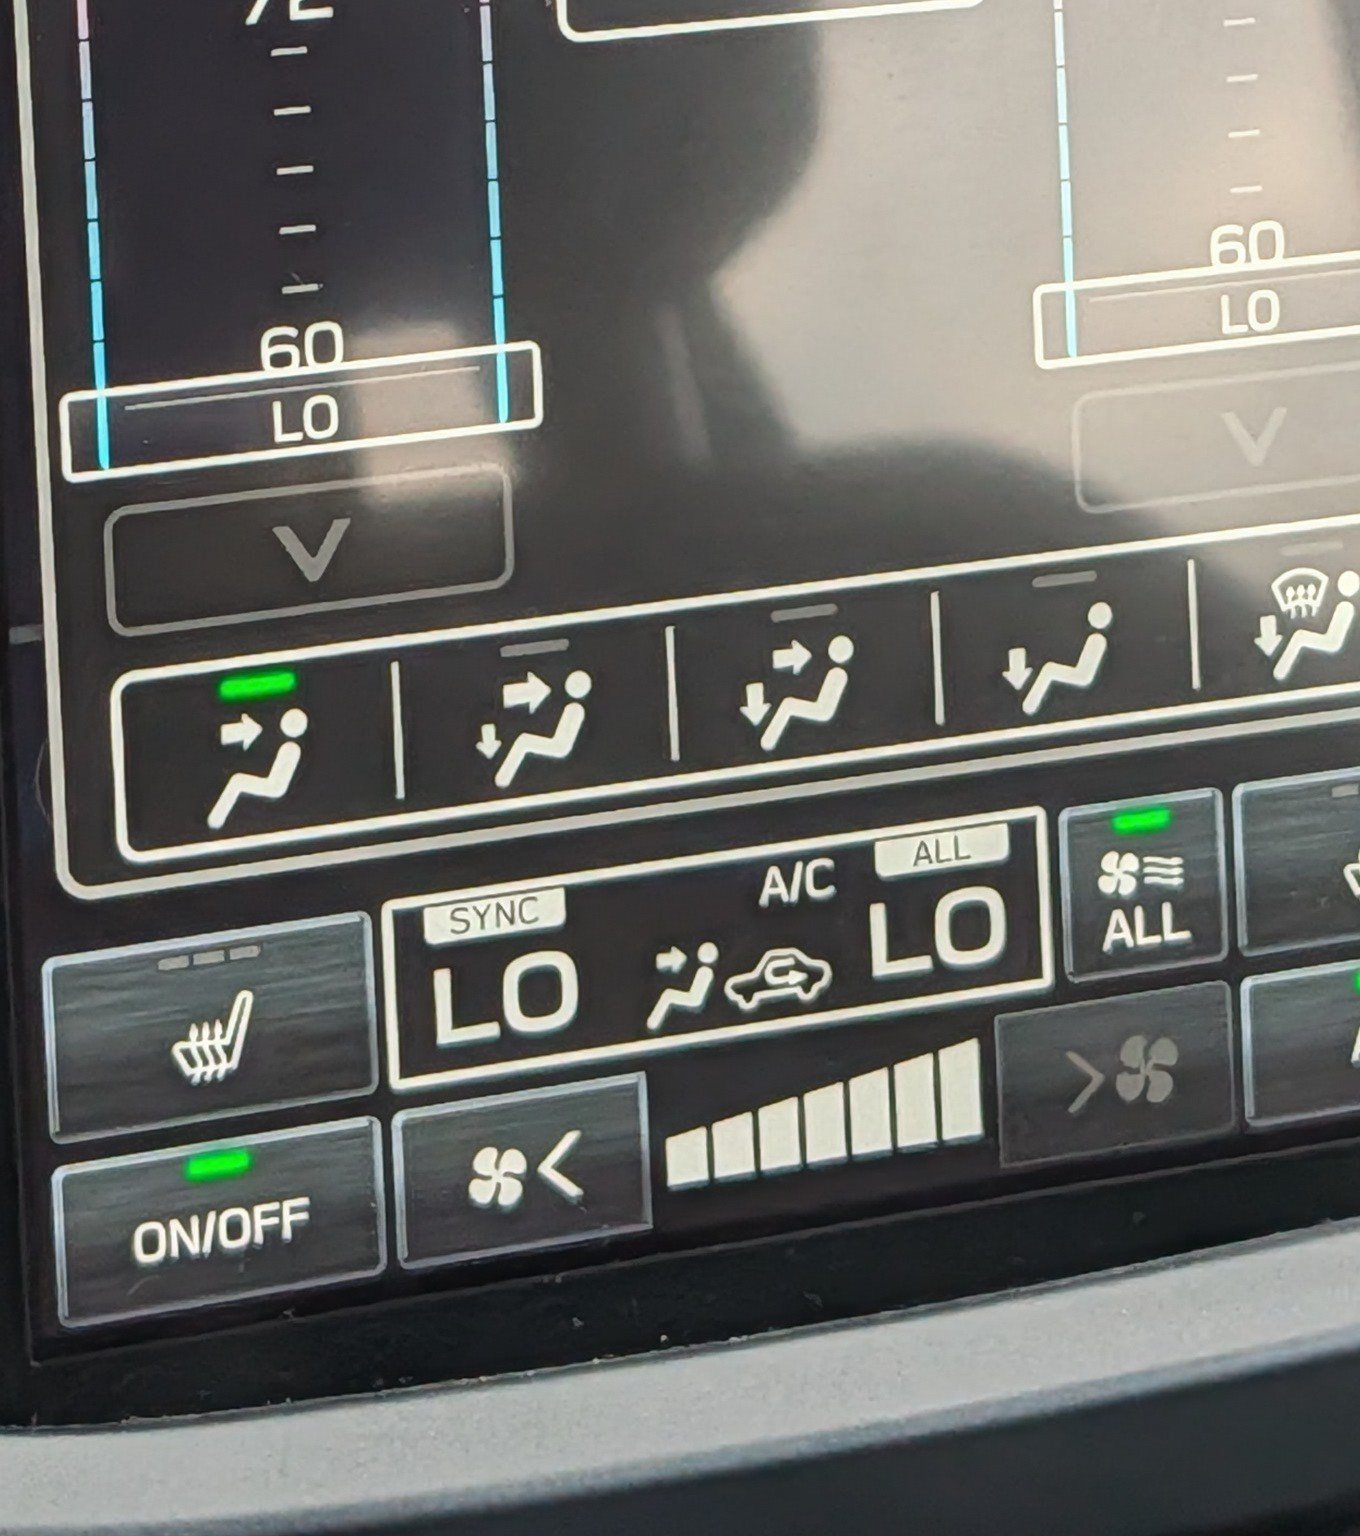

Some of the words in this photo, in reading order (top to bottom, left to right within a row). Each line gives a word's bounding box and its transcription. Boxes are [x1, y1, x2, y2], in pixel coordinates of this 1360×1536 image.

[1209, 219, 1285, 268] 60
[1220, 289, 1281, 336] LO
[259, 320, 345, 372] 60
[271, 394, 340, 443] LO
[911, 834, 973, 869] ALL
[758, 857, 837, 909] A/C
[448, 896, 541, 936] SYNC
[869, 885, 1007, 981] LO
[1102, 901, 1192, 953] ALL
[433, 949, 579, 1048] LO
[133, 1196, 311, 1266] ON/OFF
